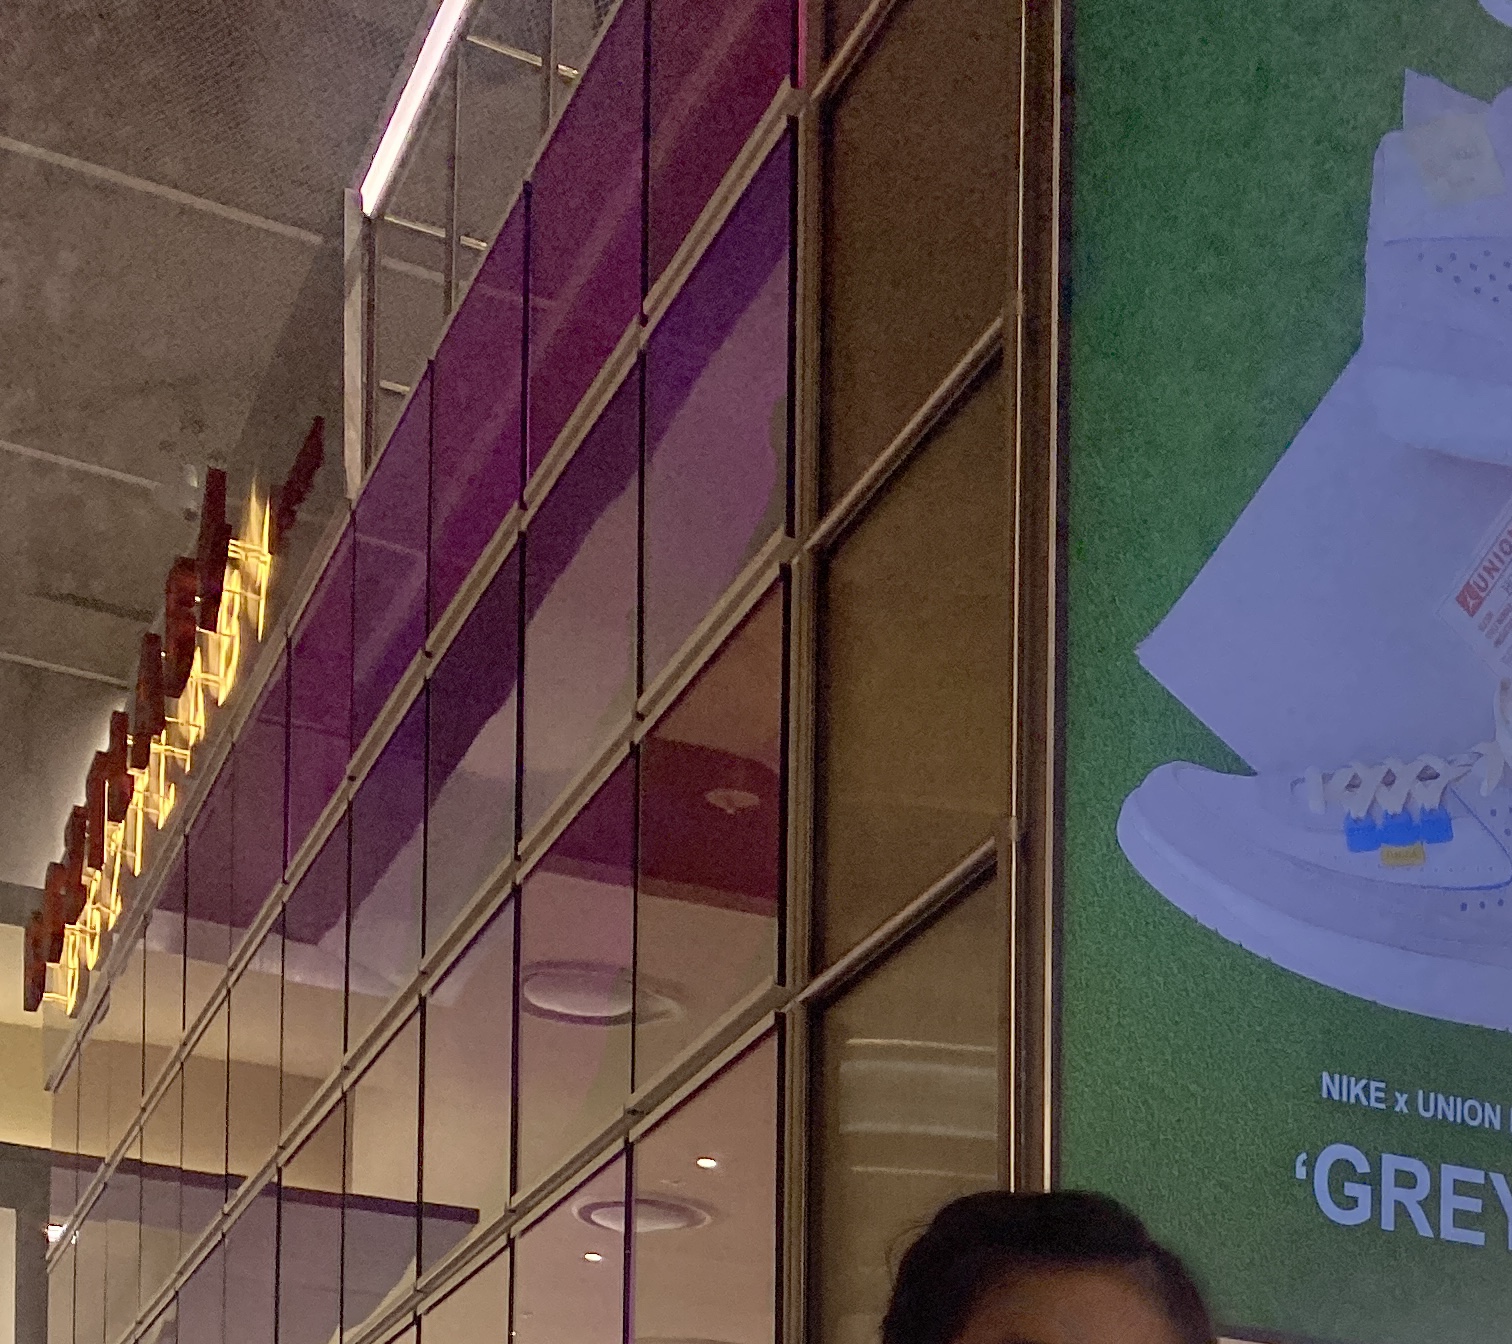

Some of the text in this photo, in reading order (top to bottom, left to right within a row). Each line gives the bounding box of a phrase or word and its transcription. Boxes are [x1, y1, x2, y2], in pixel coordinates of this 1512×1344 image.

[1320, 1071, 1387, 1110] NIKE
[1393, 1091, 1409, 1113] x
[1417, 1089, 1501, 1130] UNION
